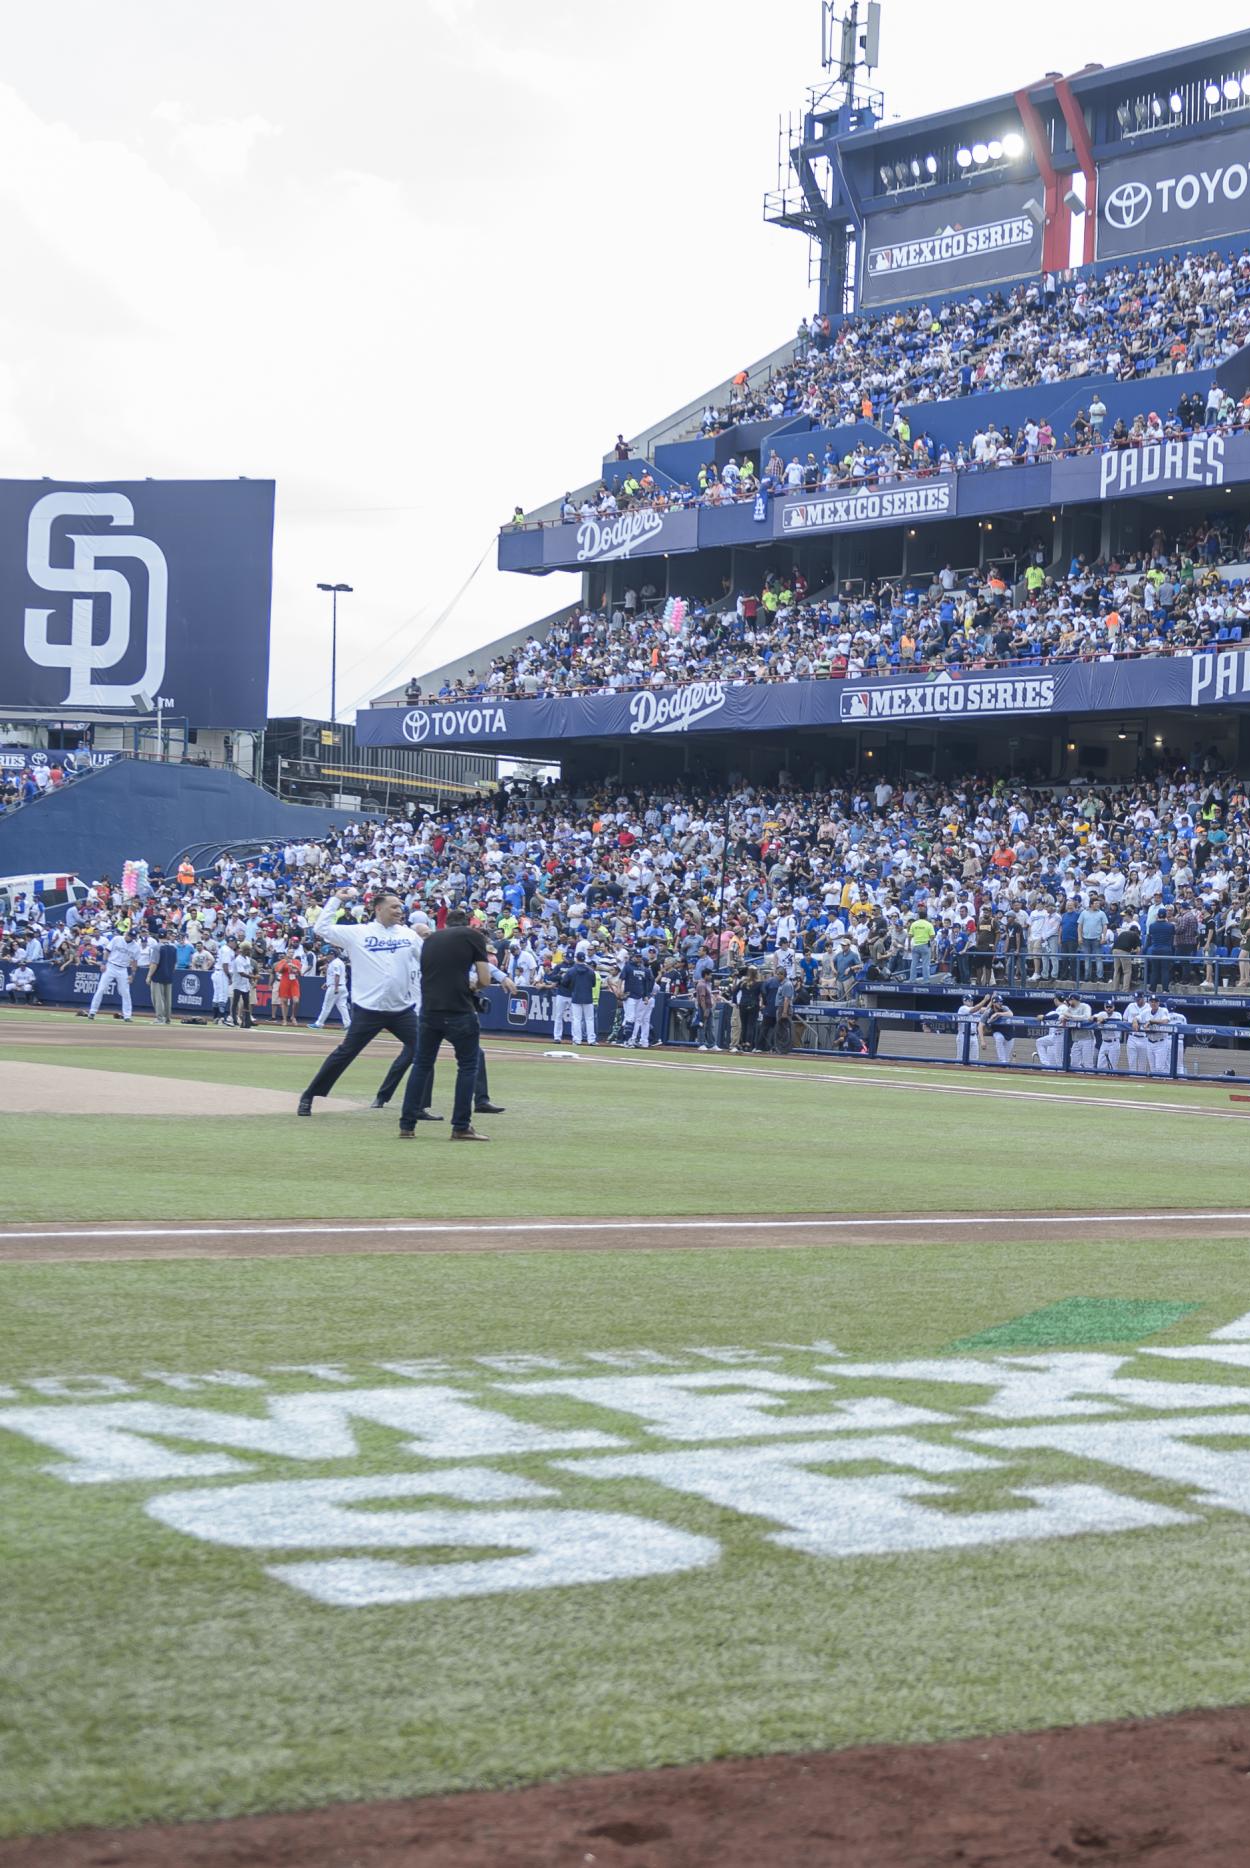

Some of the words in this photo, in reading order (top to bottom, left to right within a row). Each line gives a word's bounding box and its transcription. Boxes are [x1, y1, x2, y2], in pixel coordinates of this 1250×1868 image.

[891, 234, 964, 269] MEXICO
[966, 219, 1034, 254] SERIES
[1100, 436, 1225, 498] PADRES
[806, 497, 880, 527] MEXICO
[881, 485, 950, 516] SERIES
[576, 510, 664, 562] Dodgers
[629, 682, 726, 734] Dodgers
[870, 685, 964, 716] MEXICO
[965, 679, 1054, 711] SERIES
[432, 708, 507, 736] TOYOTA
[365, 936, 411, 954] Dodgers
